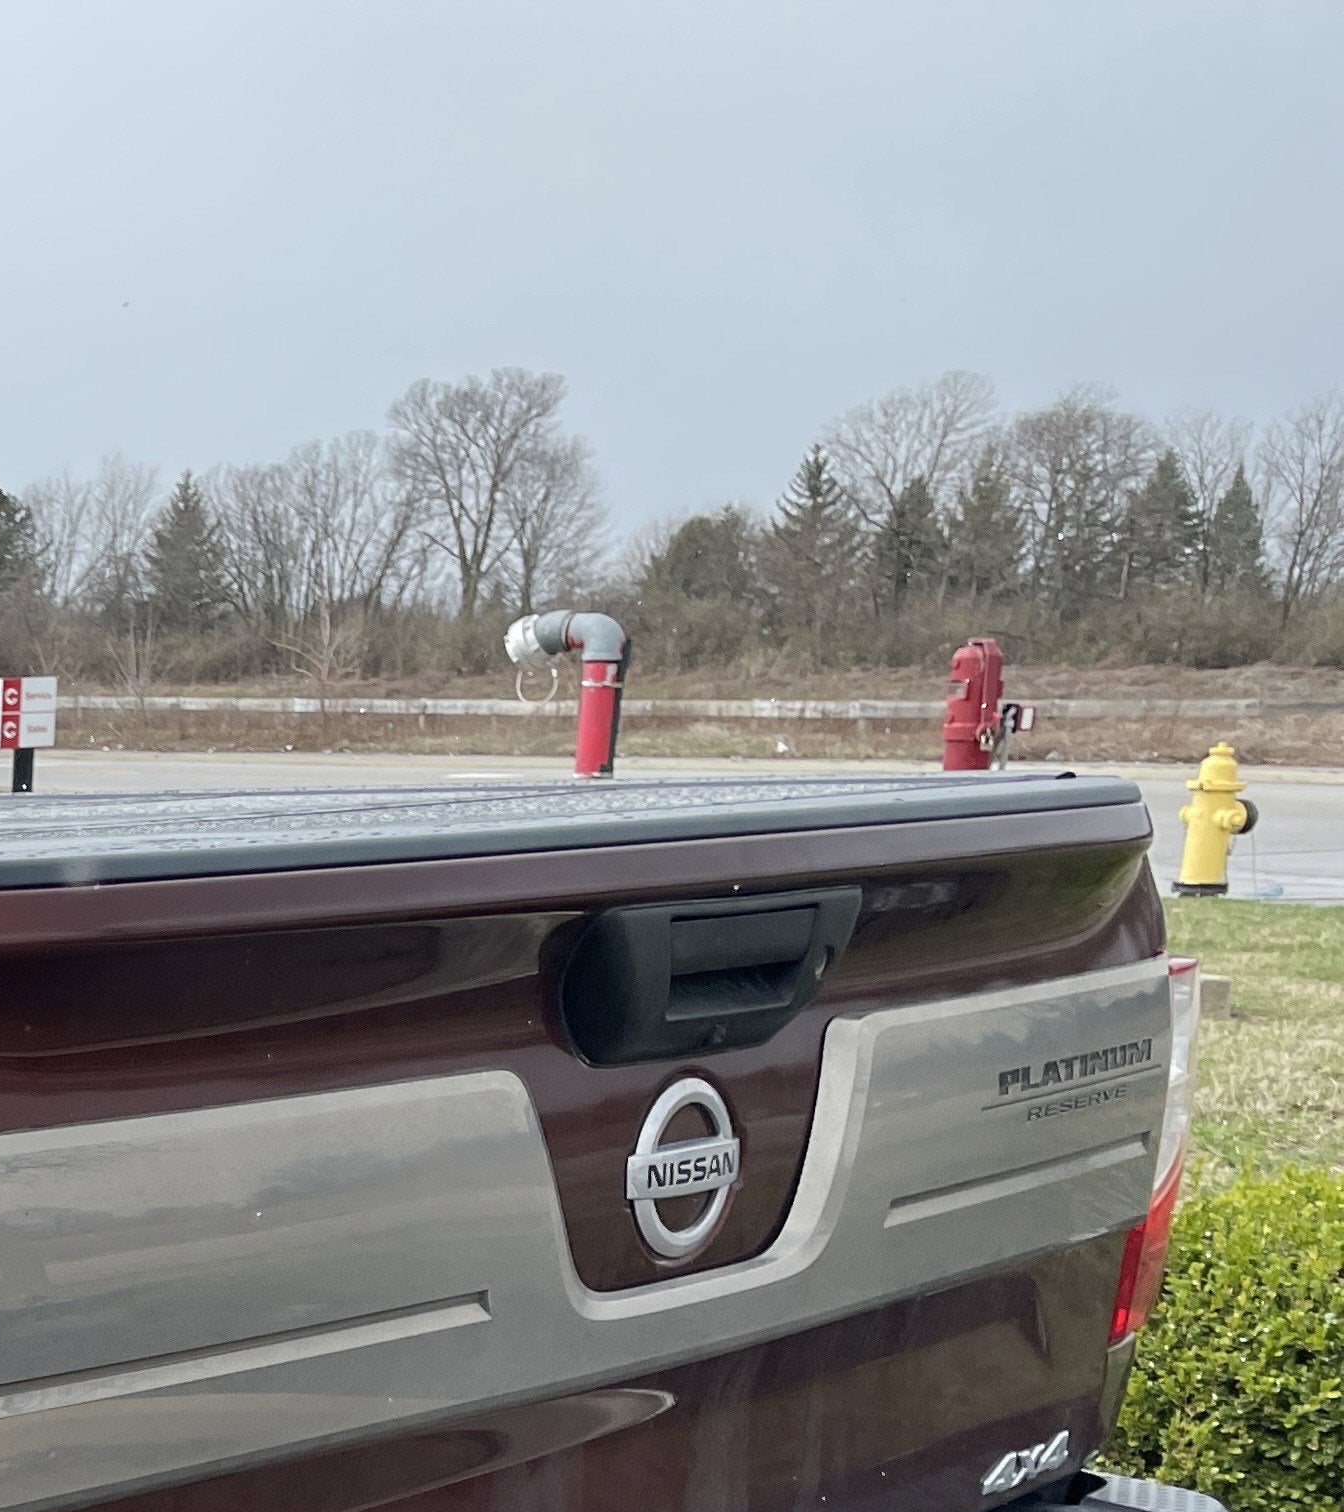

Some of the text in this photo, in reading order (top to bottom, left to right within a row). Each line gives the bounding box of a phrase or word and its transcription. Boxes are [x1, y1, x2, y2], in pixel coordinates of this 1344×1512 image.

[998, 1038, 1153, 1096] PLATINUM
[1028, 1085, 1128, 1122] RESERVE
[647, 1151, 736, 1189] NISSAN
